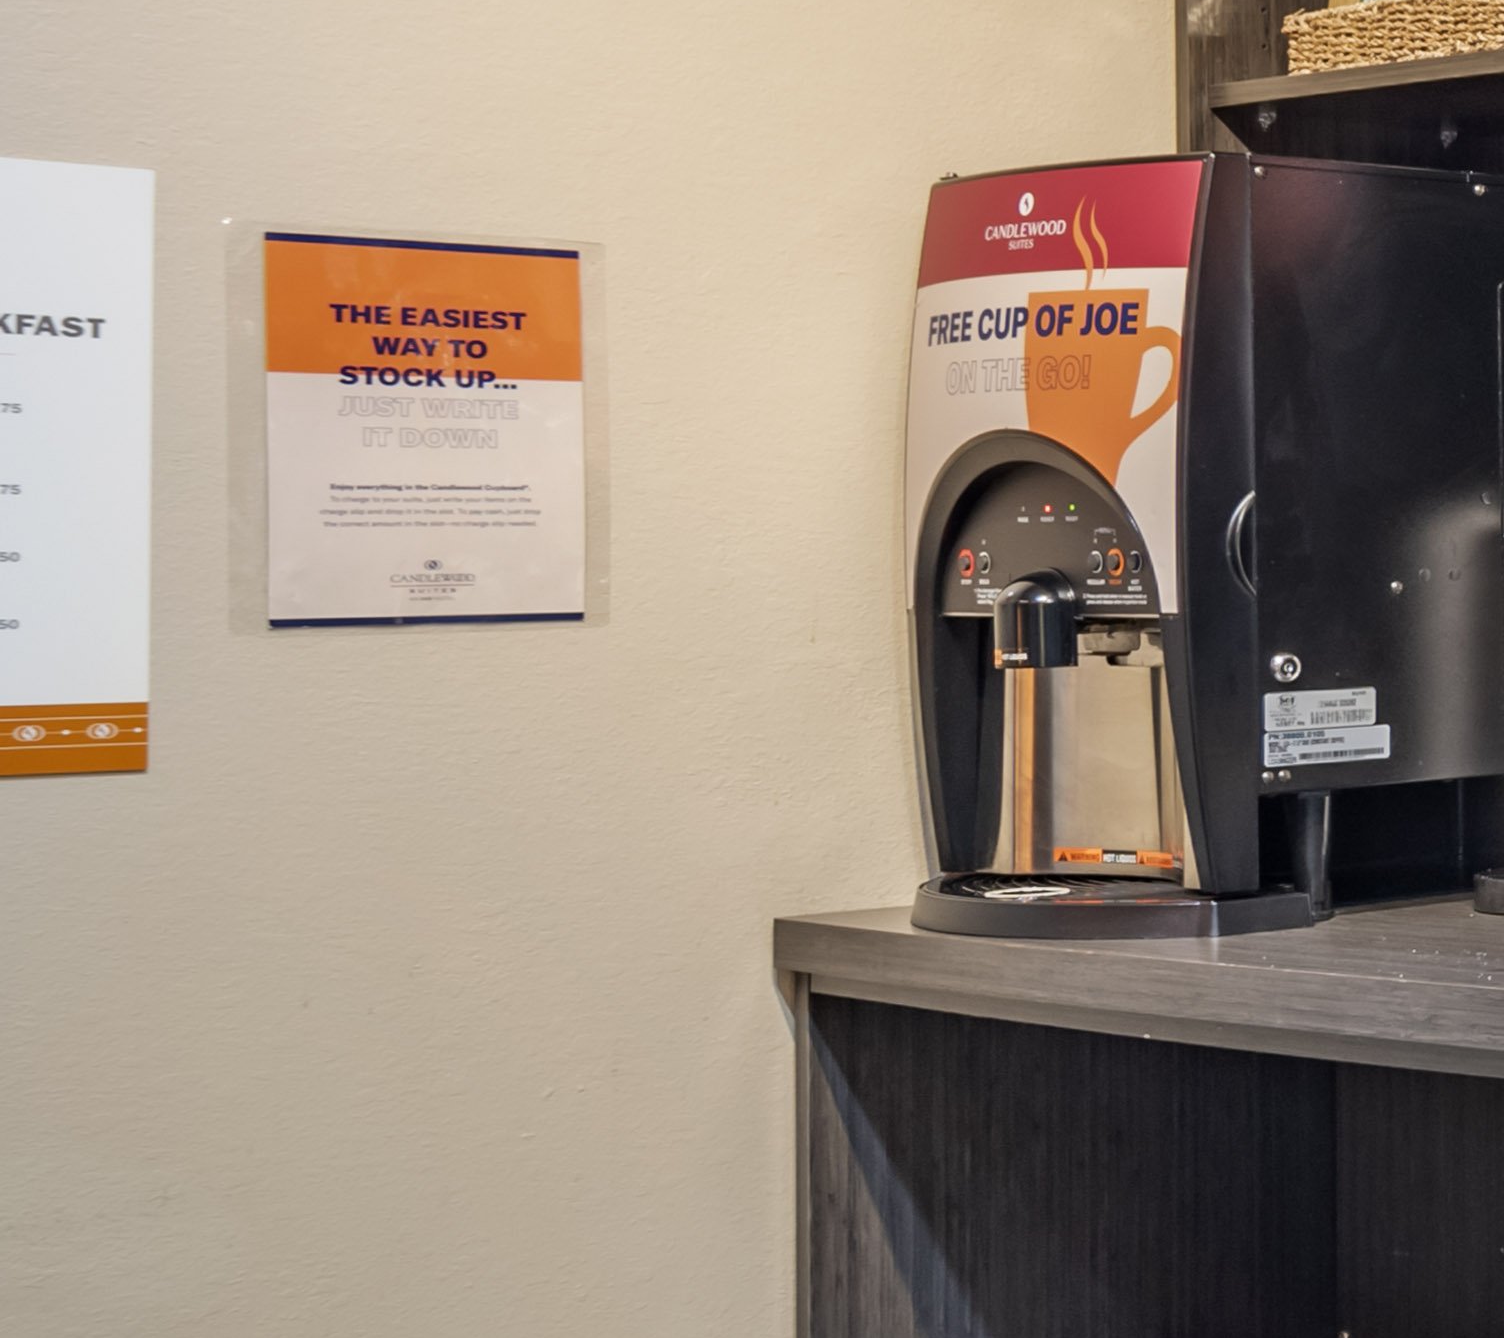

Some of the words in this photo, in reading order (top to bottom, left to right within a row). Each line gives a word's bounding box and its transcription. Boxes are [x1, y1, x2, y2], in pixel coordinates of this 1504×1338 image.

[984, 219, 1067, 241] CANDLEWOOD
[1008, 238, 1034, 250] SUITES
[329, 303, 391, 325] THE
[401, 307, 527, 330] EASIEST
[928, 310, 973, 347] FREE
[978, 307, 1029, 341] CUP
[1035, 304, 1074, 337] OF
[1080, 302, 1139, 336] JOE
[372, 336, 440, 356] WAY
[448, 339, 487, 359] TO
[339, 365, 446, 388] STOCK
[946, 358, 977, 396] ON
[981, 356, 1030, 392] THE
[1036, 354, 1091, 390] GO!
[338, 395, 415, 417] JUST
[421, 397, 520, 420] WRITE
[362, 426, 393, 448] IT
[400, 428, 498, 449] DOWN
